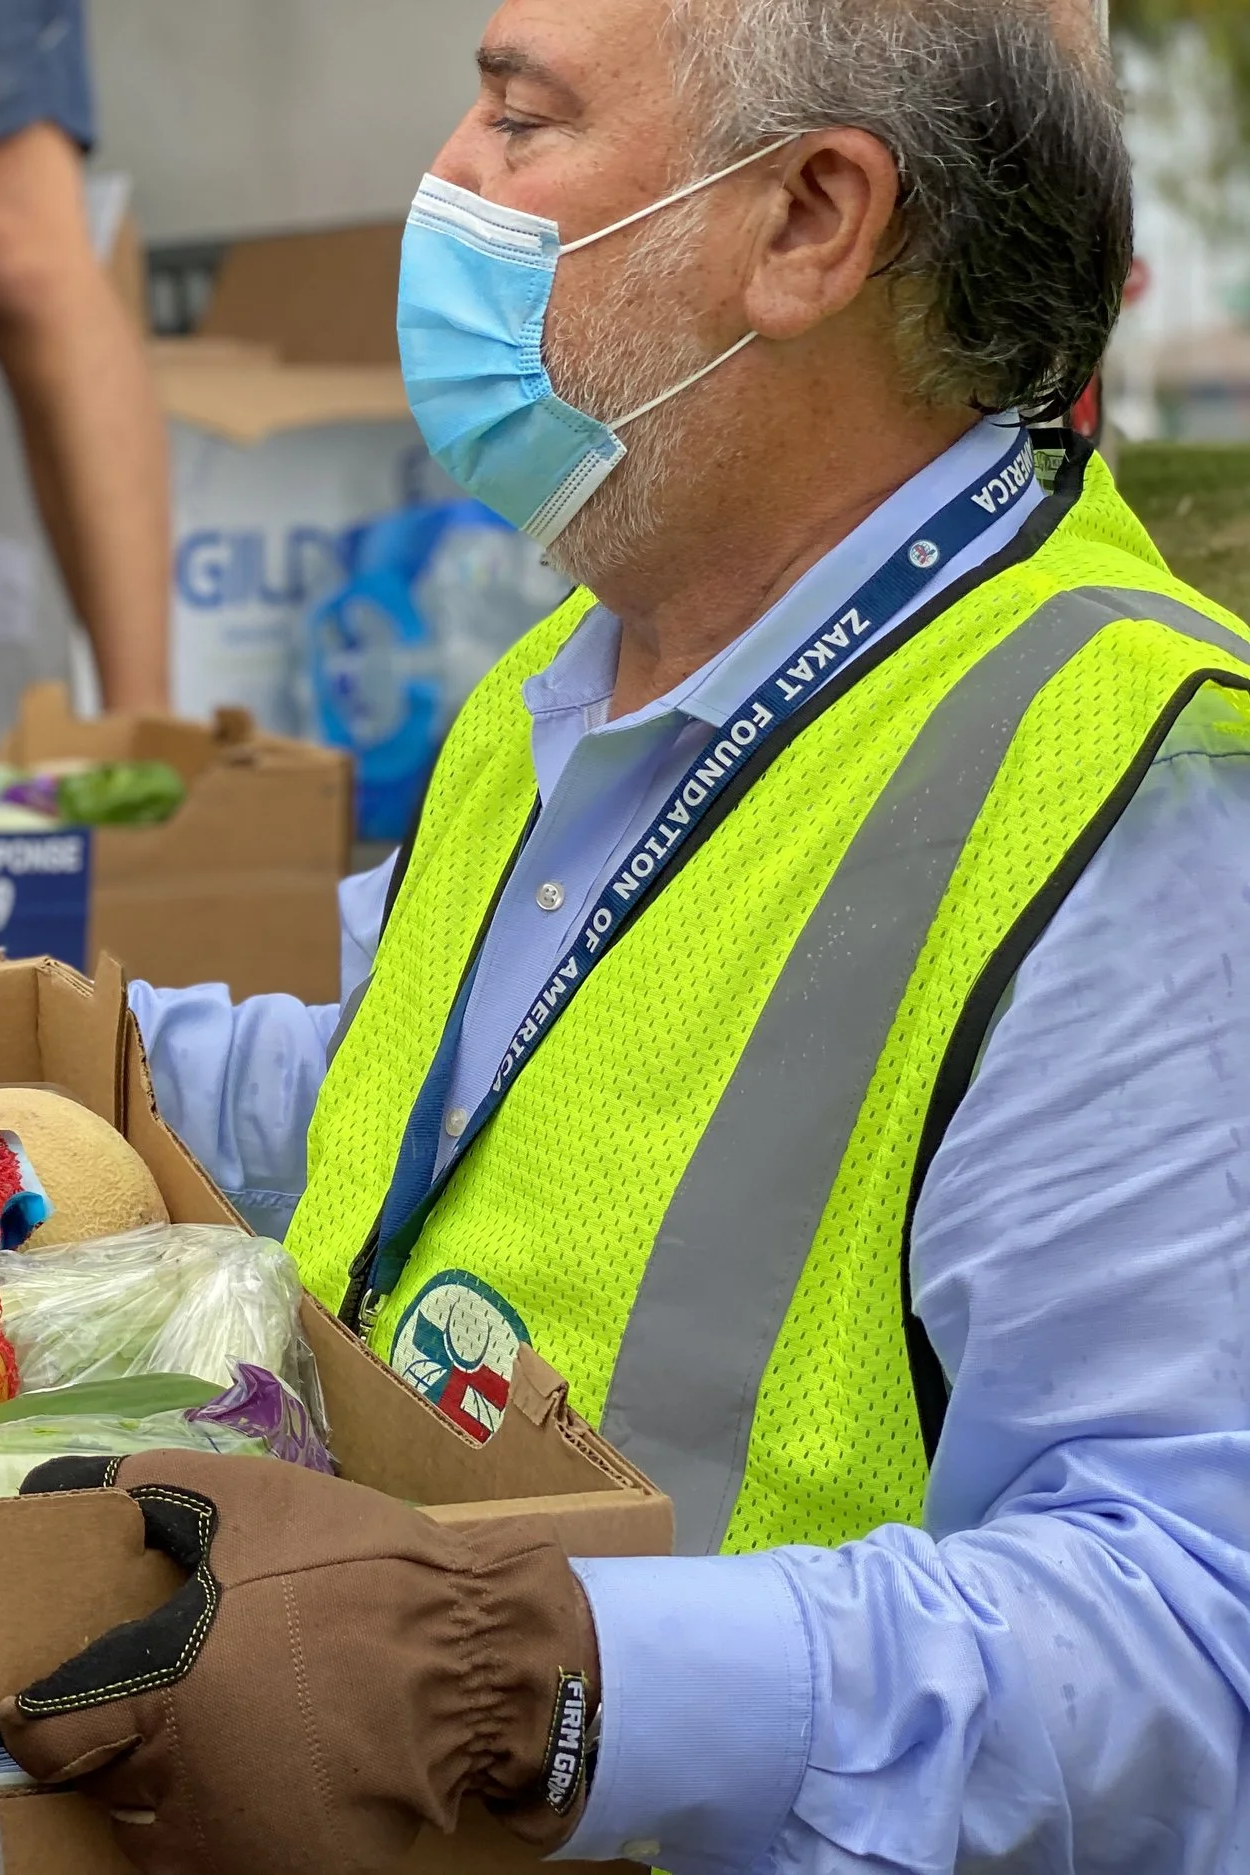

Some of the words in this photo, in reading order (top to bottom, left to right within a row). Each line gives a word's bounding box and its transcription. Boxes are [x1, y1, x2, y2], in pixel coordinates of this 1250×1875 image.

[970, 437, 1034, 514] AMERICA
[775, 608, 872, 701] ZAKAT
[613, 702, 773, 900] FOUNDATION
[584, 907, 613, 953] OF
[492, 956, 579, 1092] AMERICA
[557, 1680, 584, 1752] FIRM
